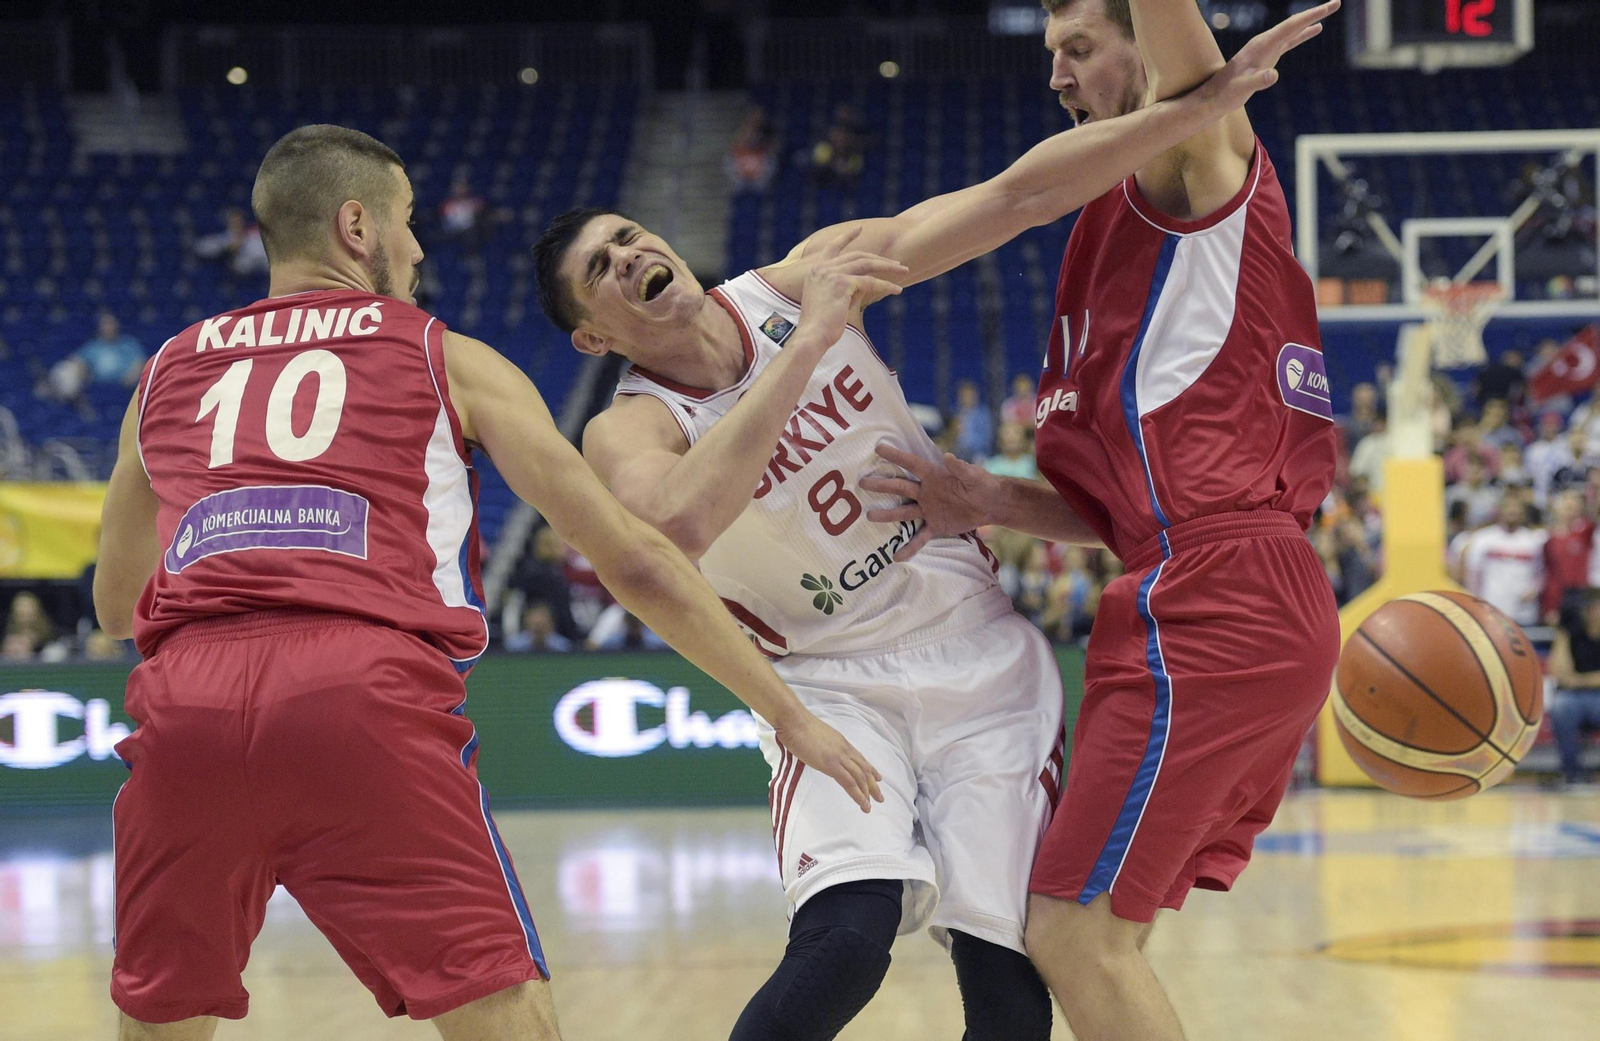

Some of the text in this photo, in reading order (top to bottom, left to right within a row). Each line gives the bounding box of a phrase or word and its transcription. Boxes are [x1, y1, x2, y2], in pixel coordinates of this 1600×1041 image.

[1445, 0, 1496, 37] 12
[195, 302, 384, 353] KALINIĆ
[195, 349, 347, 469] 10
[202, 507, 341, 534] KOMERCIJALNA BANKA
[807, 469, 862, 537] 8
[797, 858, 819, 878] adidas
